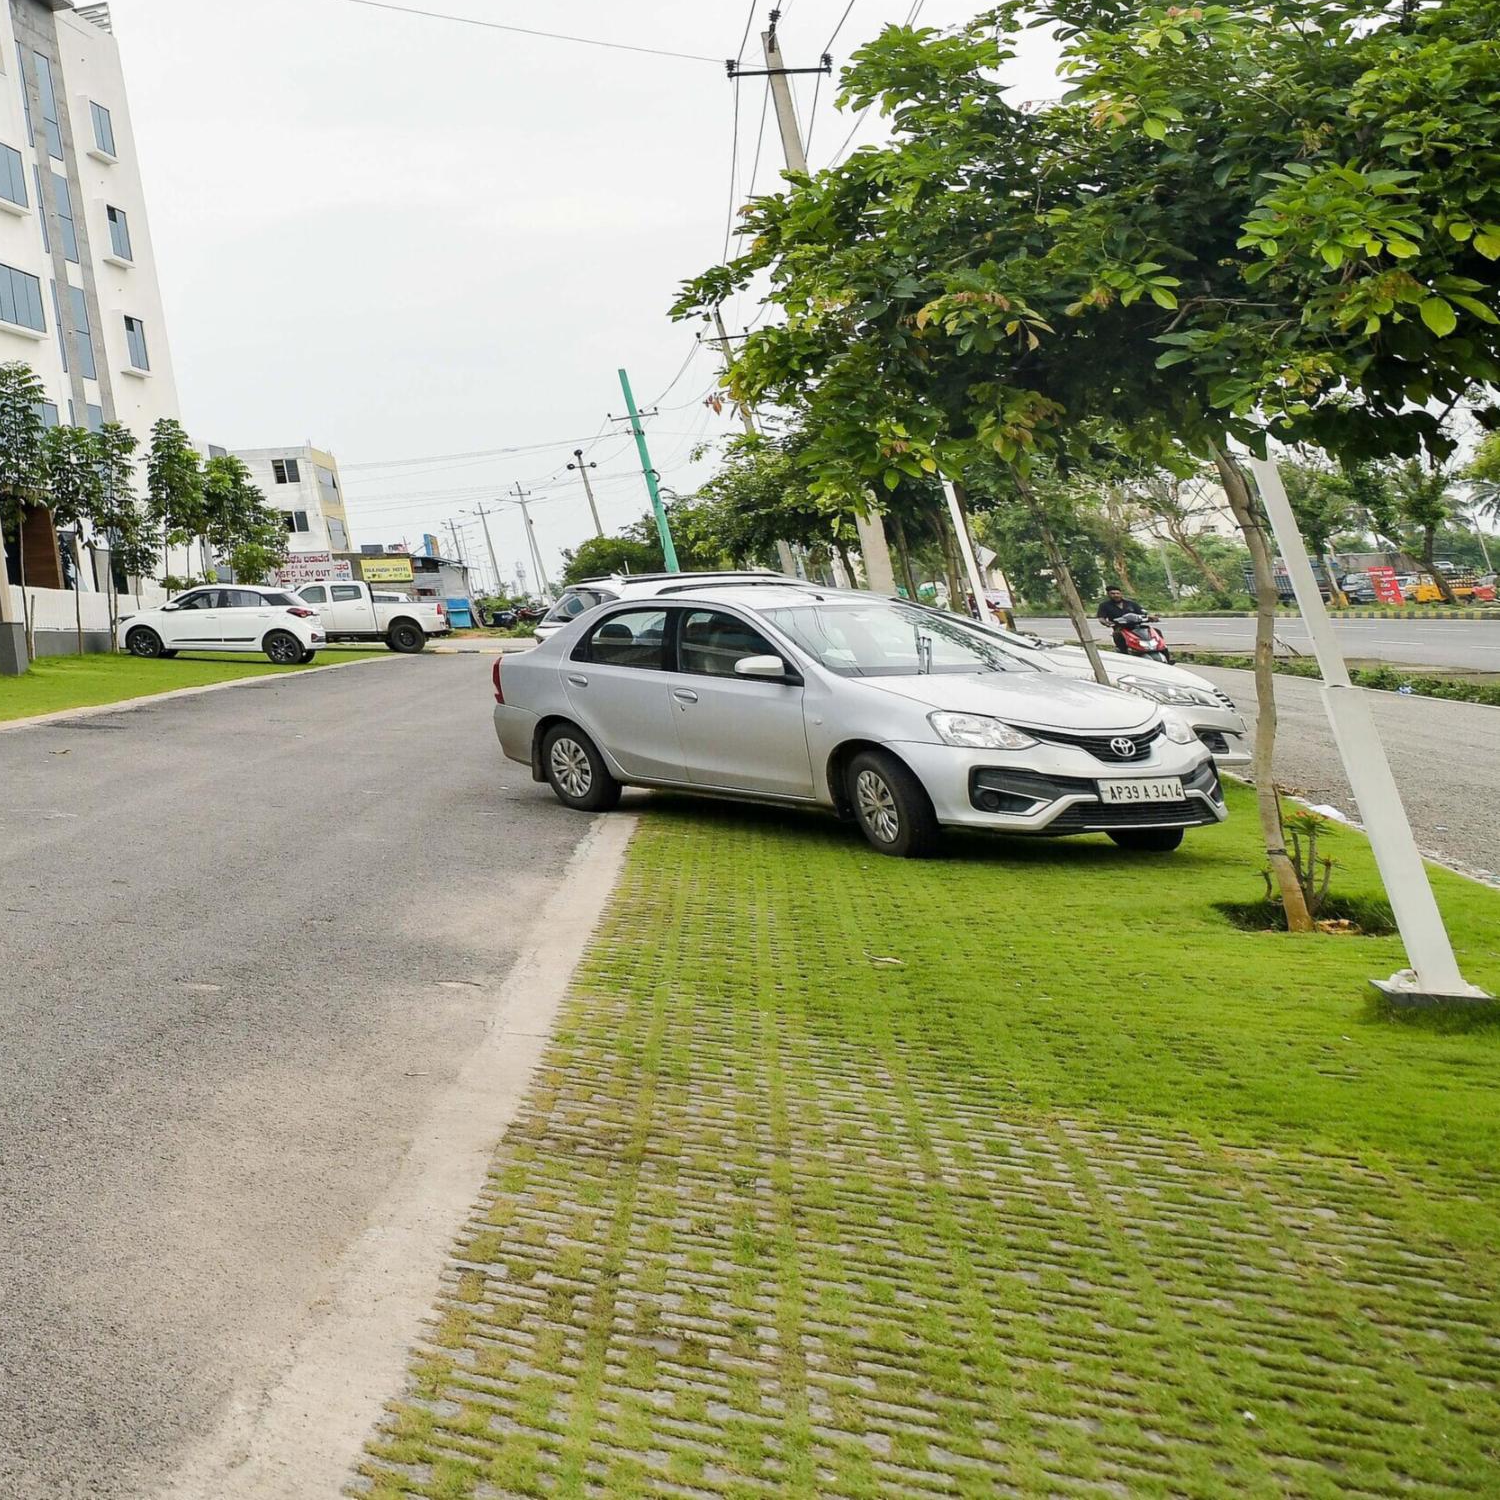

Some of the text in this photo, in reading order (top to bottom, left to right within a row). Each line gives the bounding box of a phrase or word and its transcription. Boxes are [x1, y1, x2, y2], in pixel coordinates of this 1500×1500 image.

[1109, 783, 1182, 800] AP39 A 3414
